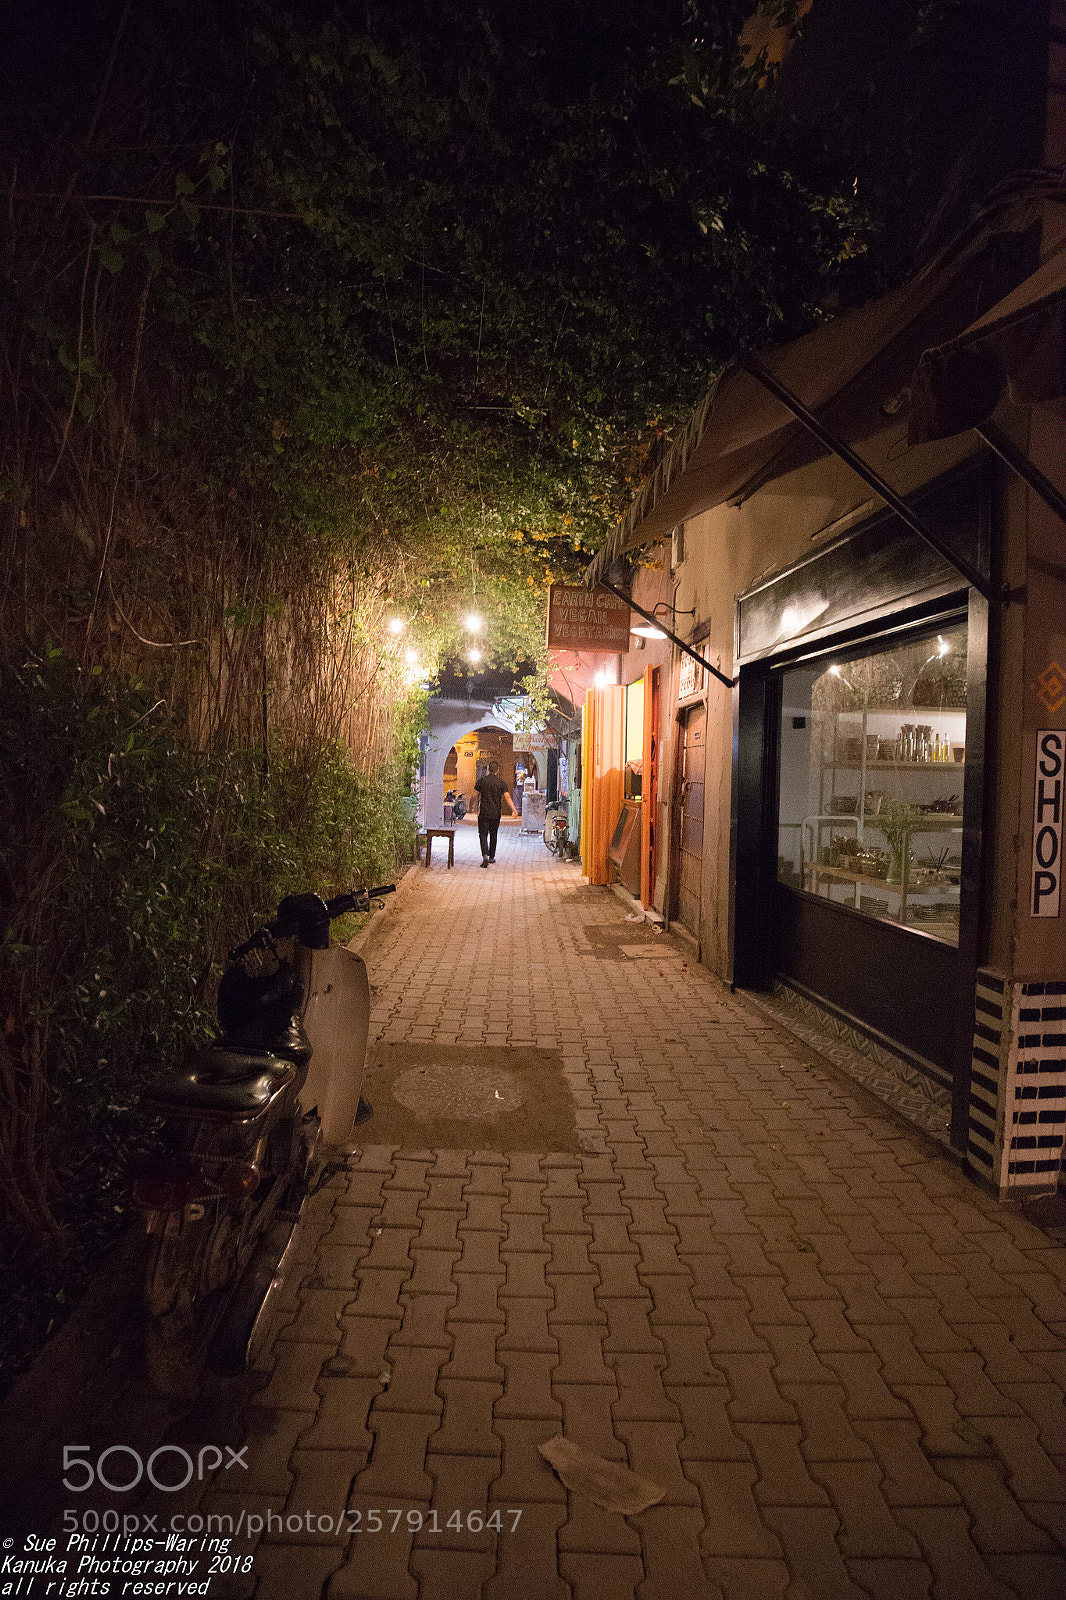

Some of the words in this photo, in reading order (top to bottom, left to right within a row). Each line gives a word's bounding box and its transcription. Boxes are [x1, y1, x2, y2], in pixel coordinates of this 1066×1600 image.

[553, 590, 594, 608] EARTH
[559, 607, 608, 625] VEGAN
[1033, 733, 1062, 915] SHOP
